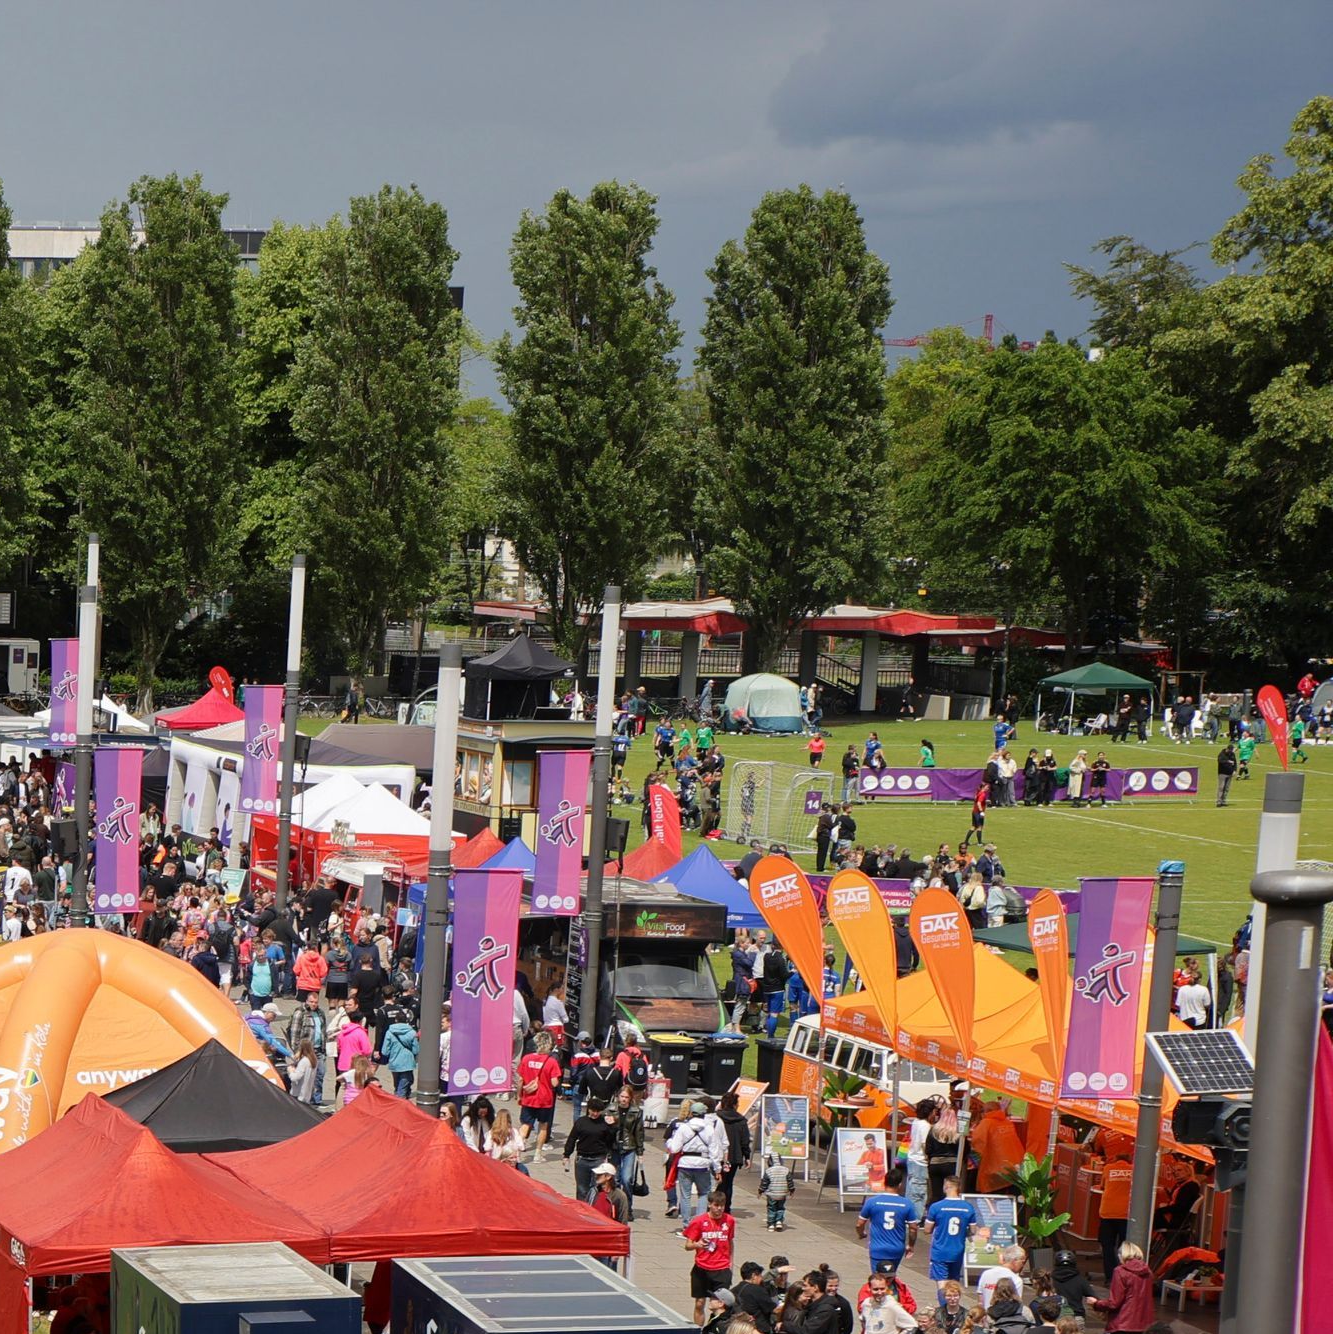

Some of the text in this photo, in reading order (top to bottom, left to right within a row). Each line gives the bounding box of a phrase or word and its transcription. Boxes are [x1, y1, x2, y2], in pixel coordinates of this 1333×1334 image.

[807, 800, 820, 809] 14
[760, 873, 800, 900] DAK
[763, 891, 803, 909] Gesundheit
[647, 922, 686, 932] VitalFood
[919, 911, 960, 934] DAK
[1033, 914, 1060, 937] DAK
[920, 931, 961, 945] Gesundheit
[76, 1069, 159, 1089] anywa
[1039, 1079, 1056, 1097] DAK
[883, 1211, 896, 1231] 5
[947, 1216, 961, 1236] 6
